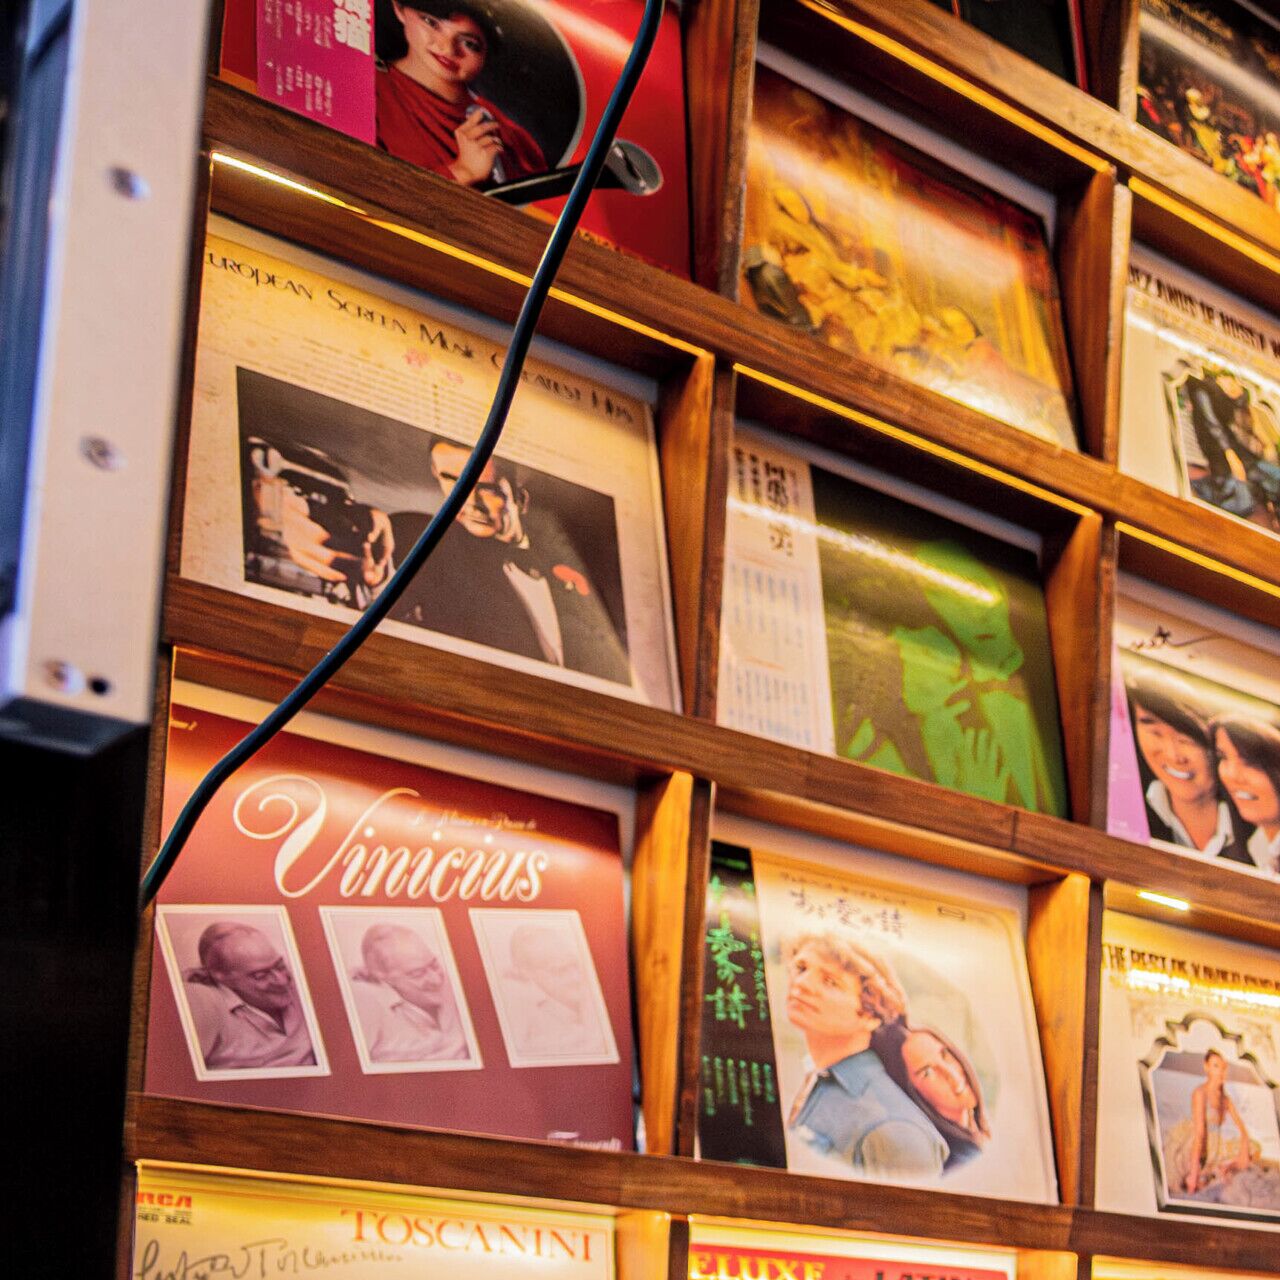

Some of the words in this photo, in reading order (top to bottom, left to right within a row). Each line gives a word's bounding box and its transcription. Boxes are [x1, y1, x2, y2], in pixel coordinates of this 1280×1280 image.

[206, 250, 314, 301] UROPEAN
[232, 773, 549, 902] Vinicius
[136, 1191, 192, 1209] RCA
[340, 1208, 593, 1262] TOSCANINI
